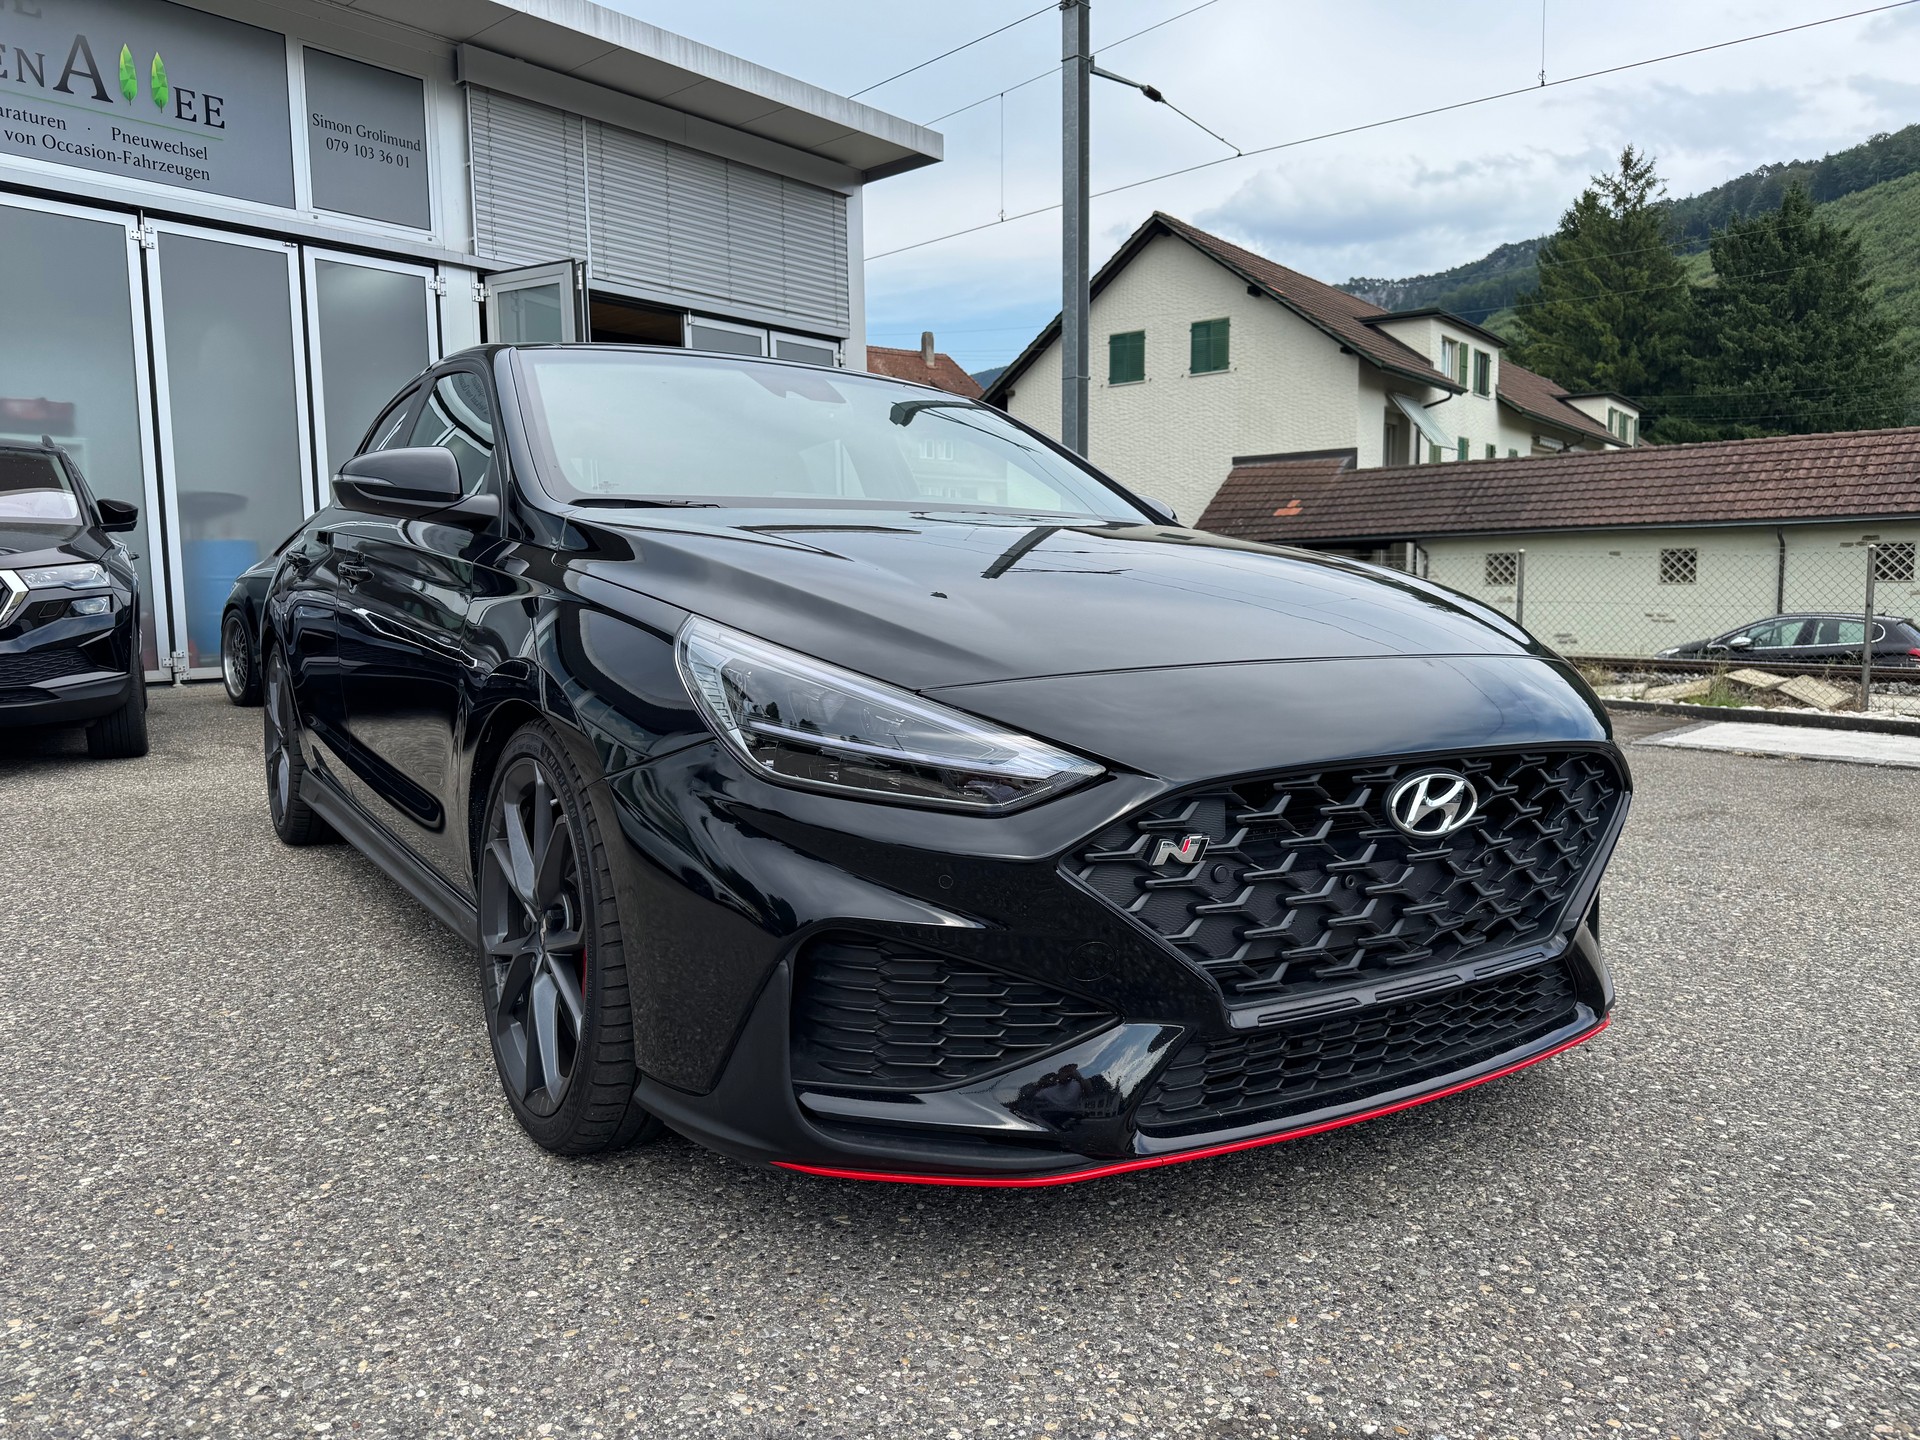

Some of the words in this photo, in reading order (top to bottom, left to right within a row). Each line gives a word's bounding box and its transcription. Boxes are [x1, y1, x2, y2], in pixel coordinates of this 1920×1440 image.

[111, 126, 208, 161] Pneuwechsel
[312, 113, 352, 135] Simon
[356, 124, 421, 152] Grolimund
[4, 129, 37, 147] von
[42, 133, 210, 181] Occasion-Fahrzeugen
[326, 137, 349, 154] 079
[354, 144, 375, 160] 103
[379, 150, 393, 165] 36
[396, 154, 410, 169] 01
[547, 755, 577, 819] MICHELIN
[1151, 834, 1211, 866] N
